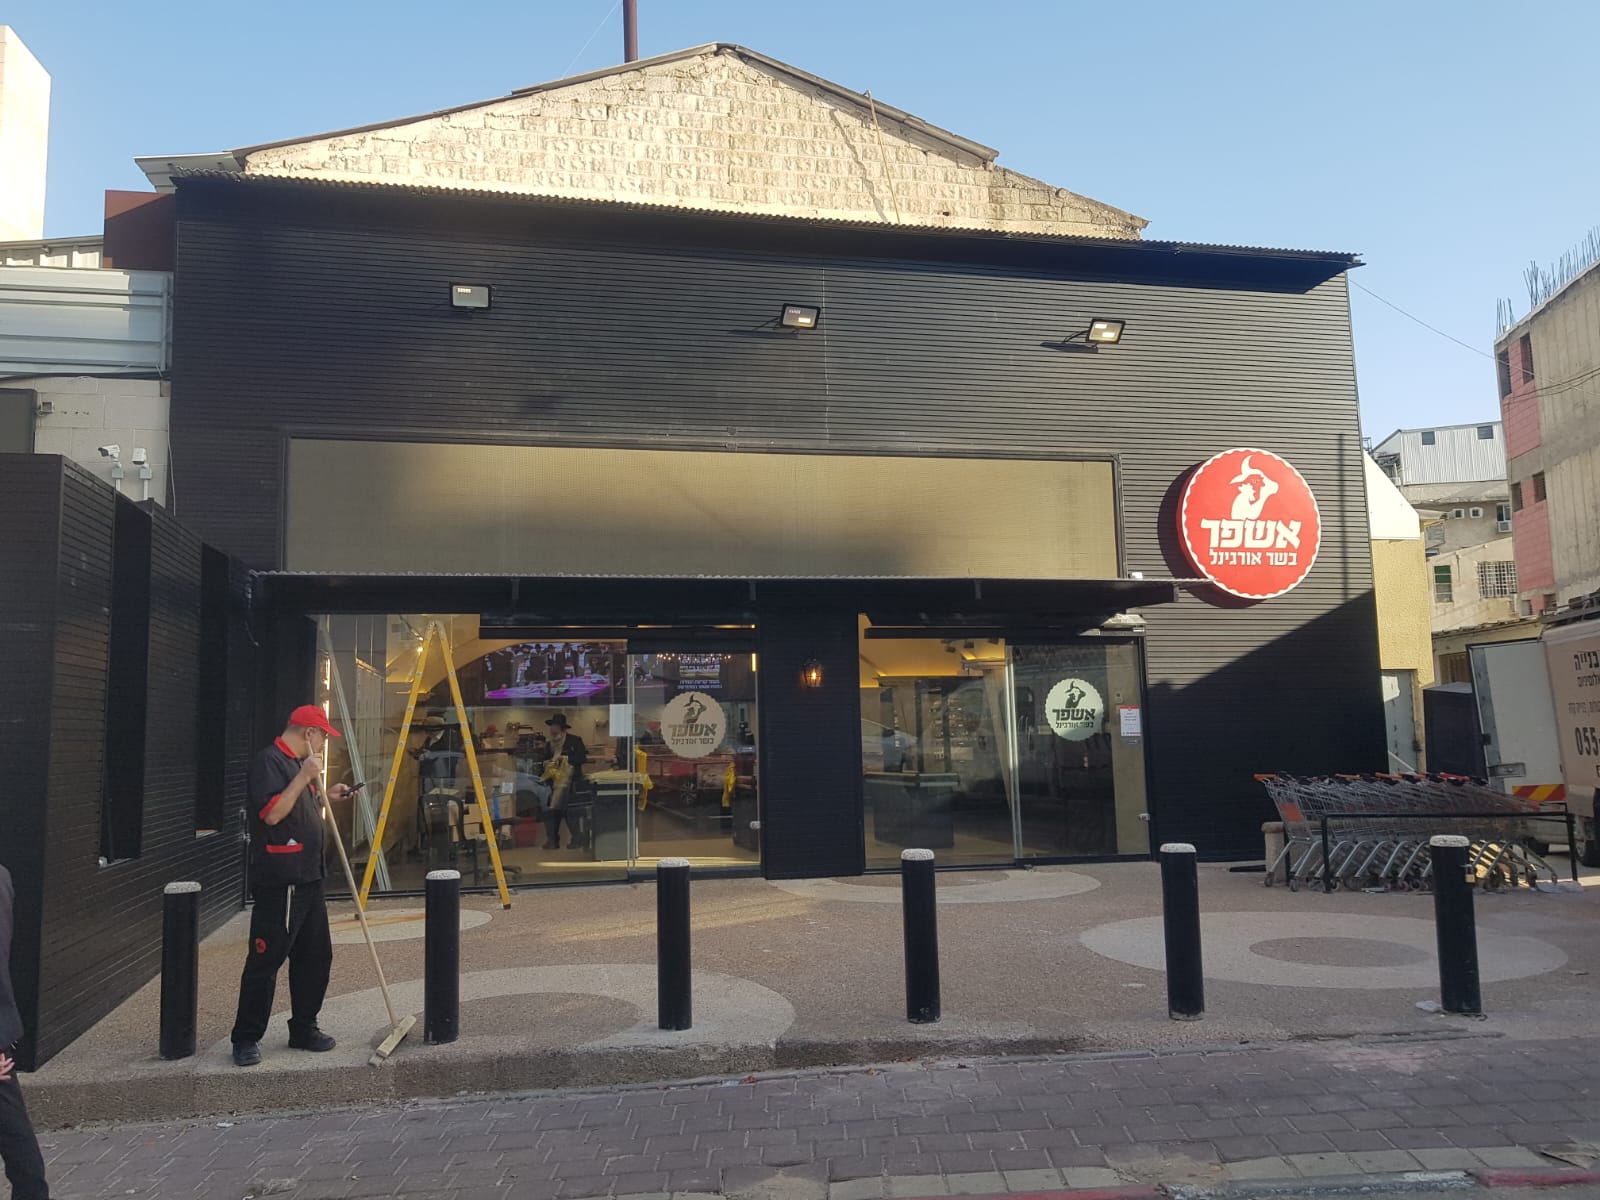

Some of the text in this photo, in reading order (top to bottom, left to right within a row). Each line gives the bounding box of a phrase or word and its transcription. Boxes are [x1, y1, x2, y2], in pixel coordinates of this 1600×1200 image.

[1200, 518, 1302, 549] אשפר
[1209, 549, 1298, 566] בשר אורגינל
[1052, 708, 1096, 721] אשפר
[667, 723, 718, 737] אשפר
[1574, 726, 1600, 756] 055
